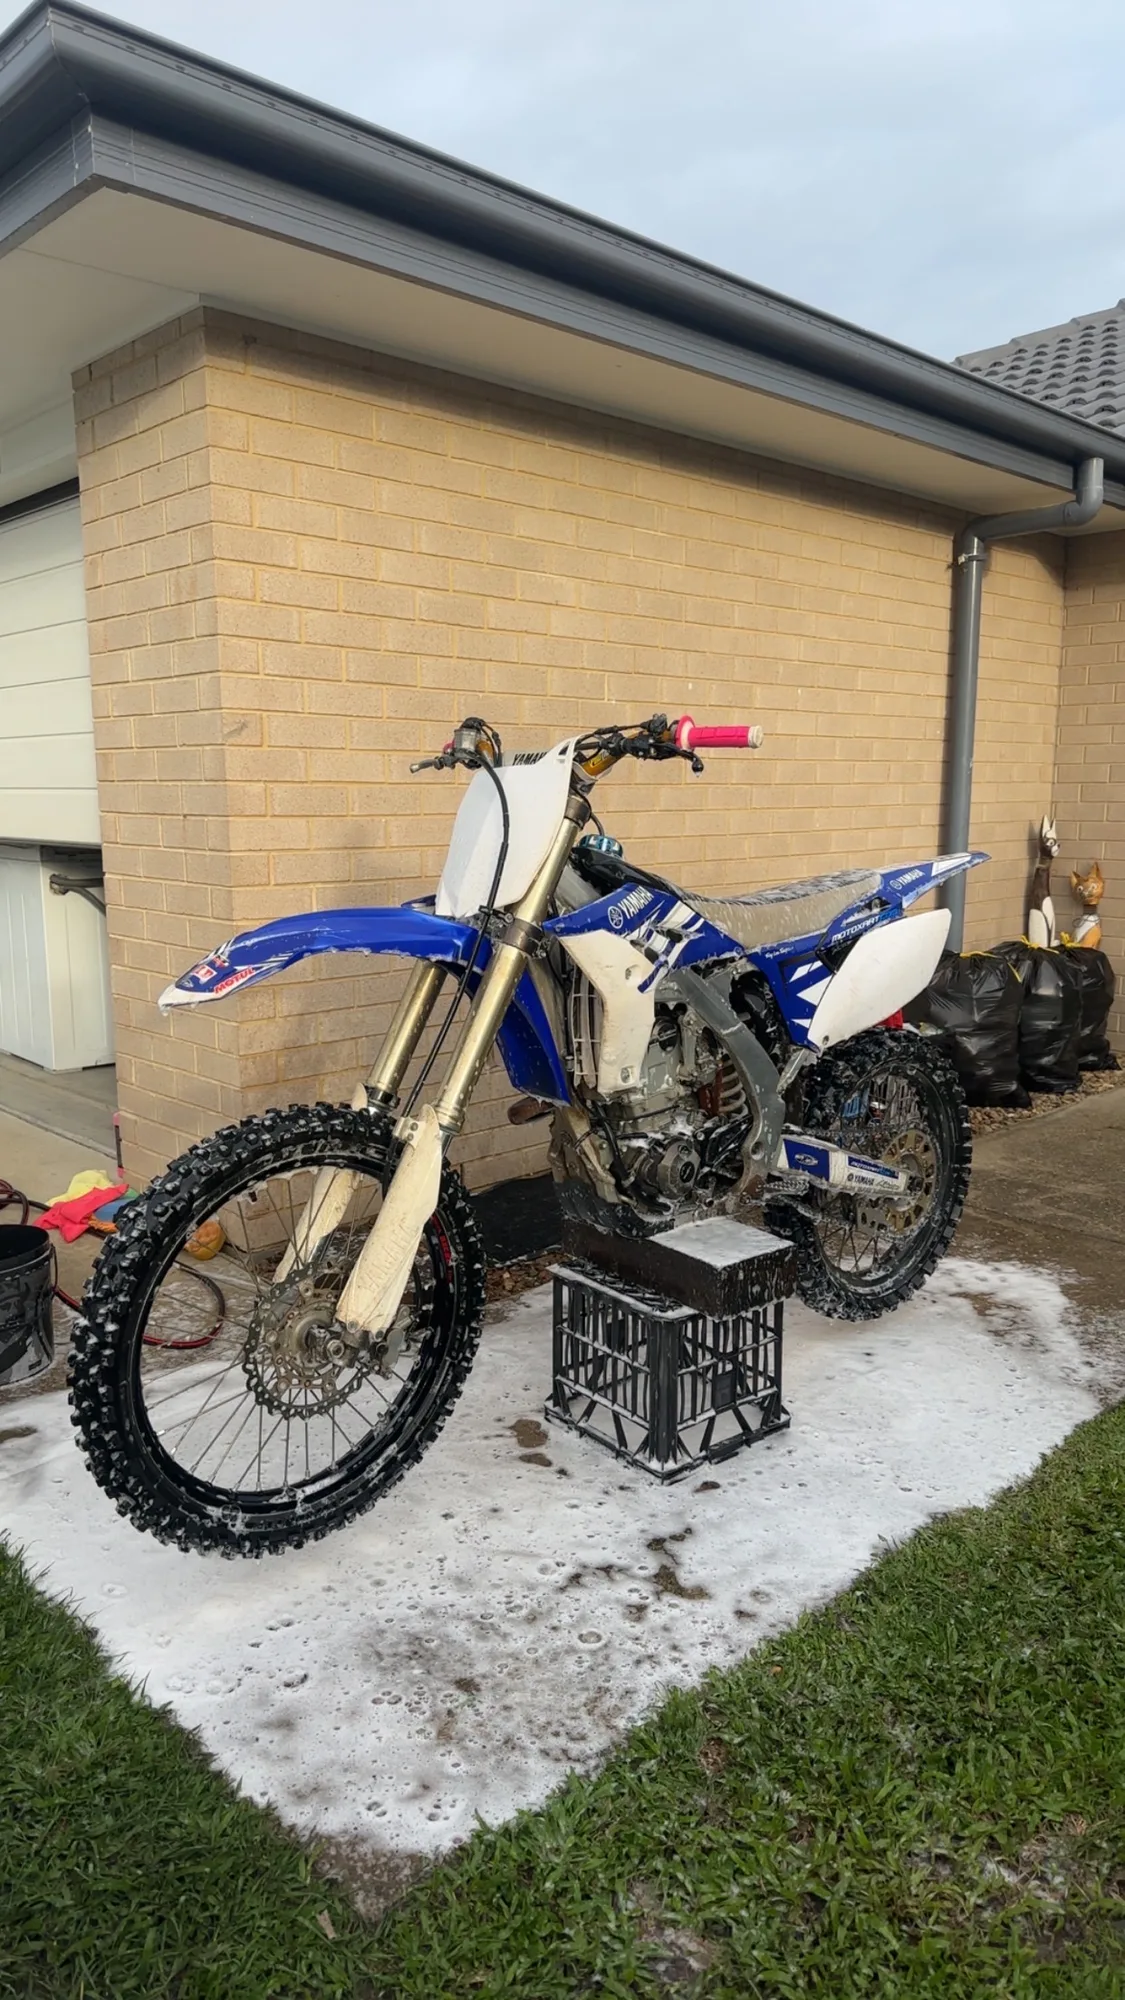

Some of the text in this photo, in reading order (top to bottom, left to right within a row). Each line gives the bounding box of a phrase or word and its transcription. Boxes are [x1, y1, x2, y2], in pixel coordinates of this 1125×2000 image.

[896, 868, 925, 886] YAMAHA
[617, 885, 655, 919] YAMAHA
[214, 965, 254, 994] MOTUL
